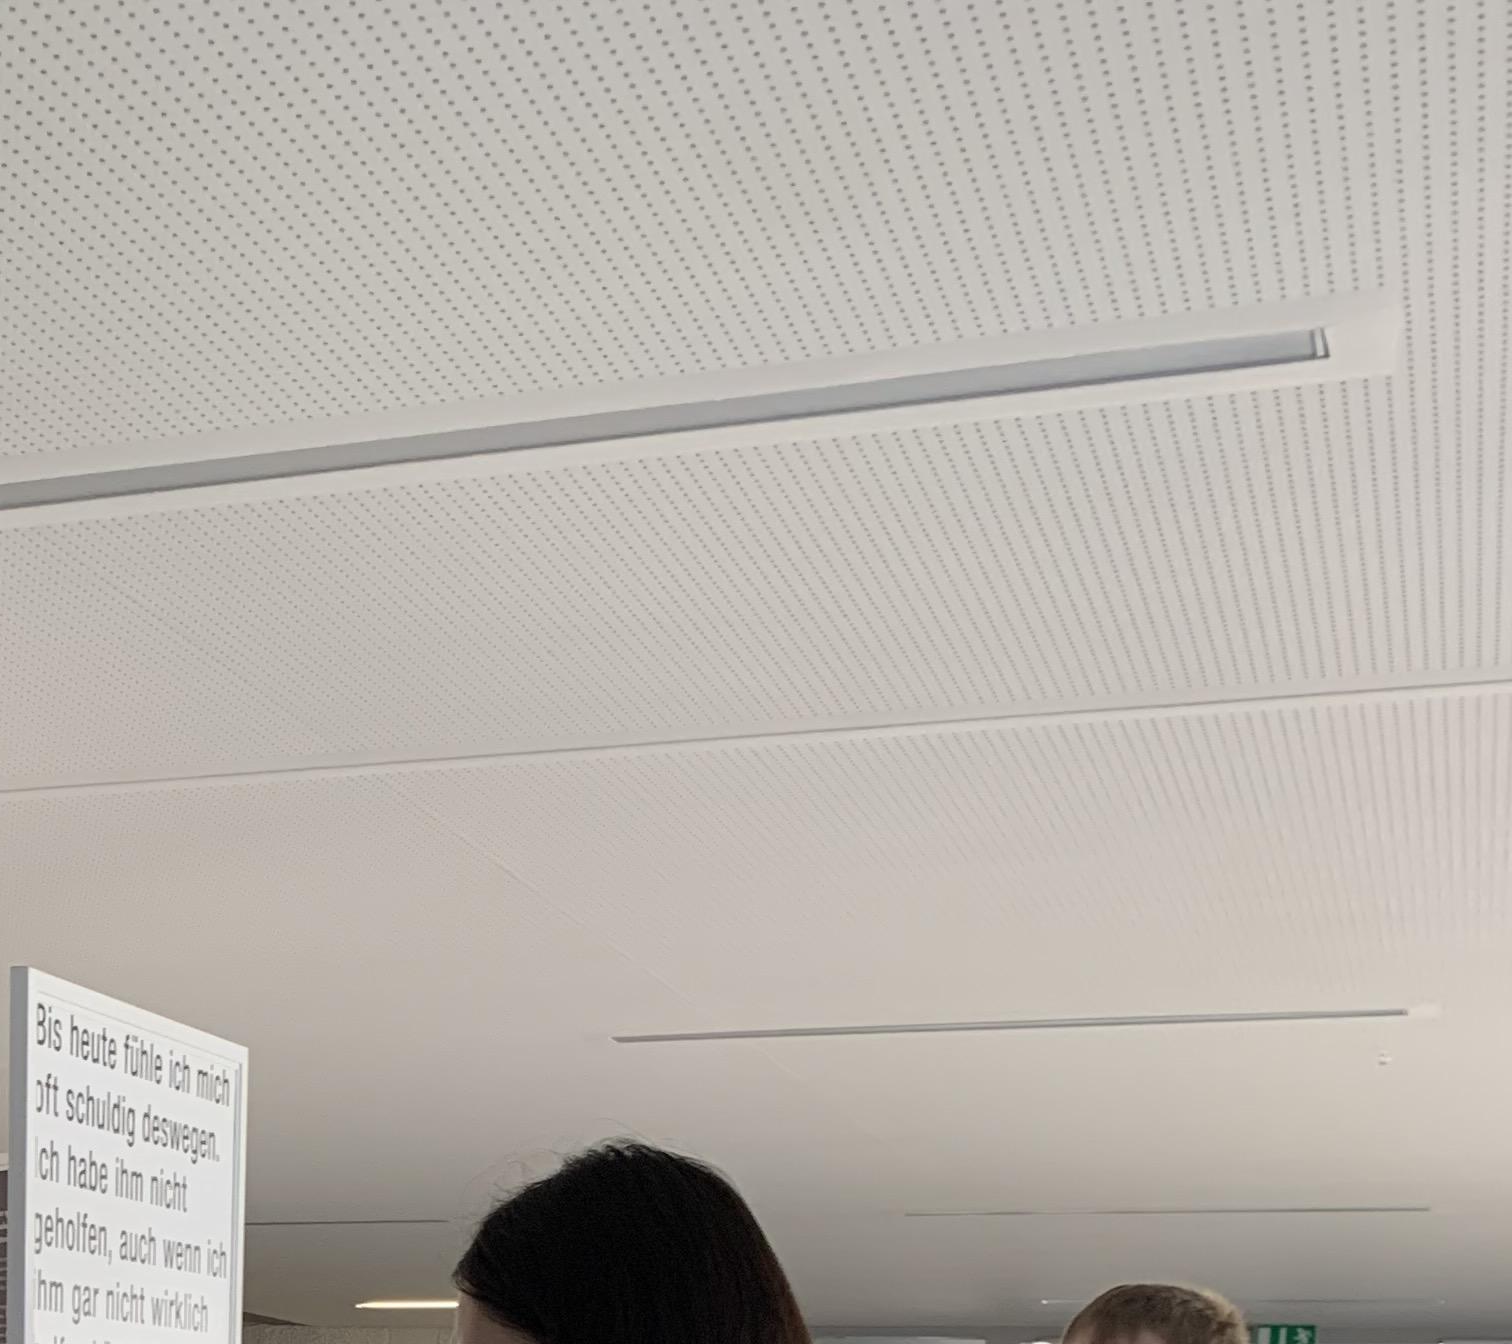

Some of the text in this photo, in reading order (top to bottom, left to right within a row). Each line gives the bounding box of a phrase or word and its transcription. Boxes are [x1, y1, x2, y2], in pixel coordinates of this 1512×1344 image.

[36, 1002, 230, 1107] Bis heute fühle ich mich
[65, 1085, 136, 1148] schuldig
[142, 1104, 220, 1165] deswegen.
[35, 1136, 188, 1213] Ich habe ihm nicht
[34, 1207, 113, 1265] geholfen,
[119, 1227, 157, 1266] auch
[163, 1238, 202, 1274] wenn
[206, 1239, 227, 1279] ich
[72, 1282, 100, 1325] gar
[105, 1281, 145, 1325] nicht
[151, 1289, 209, 1333] wirklich
